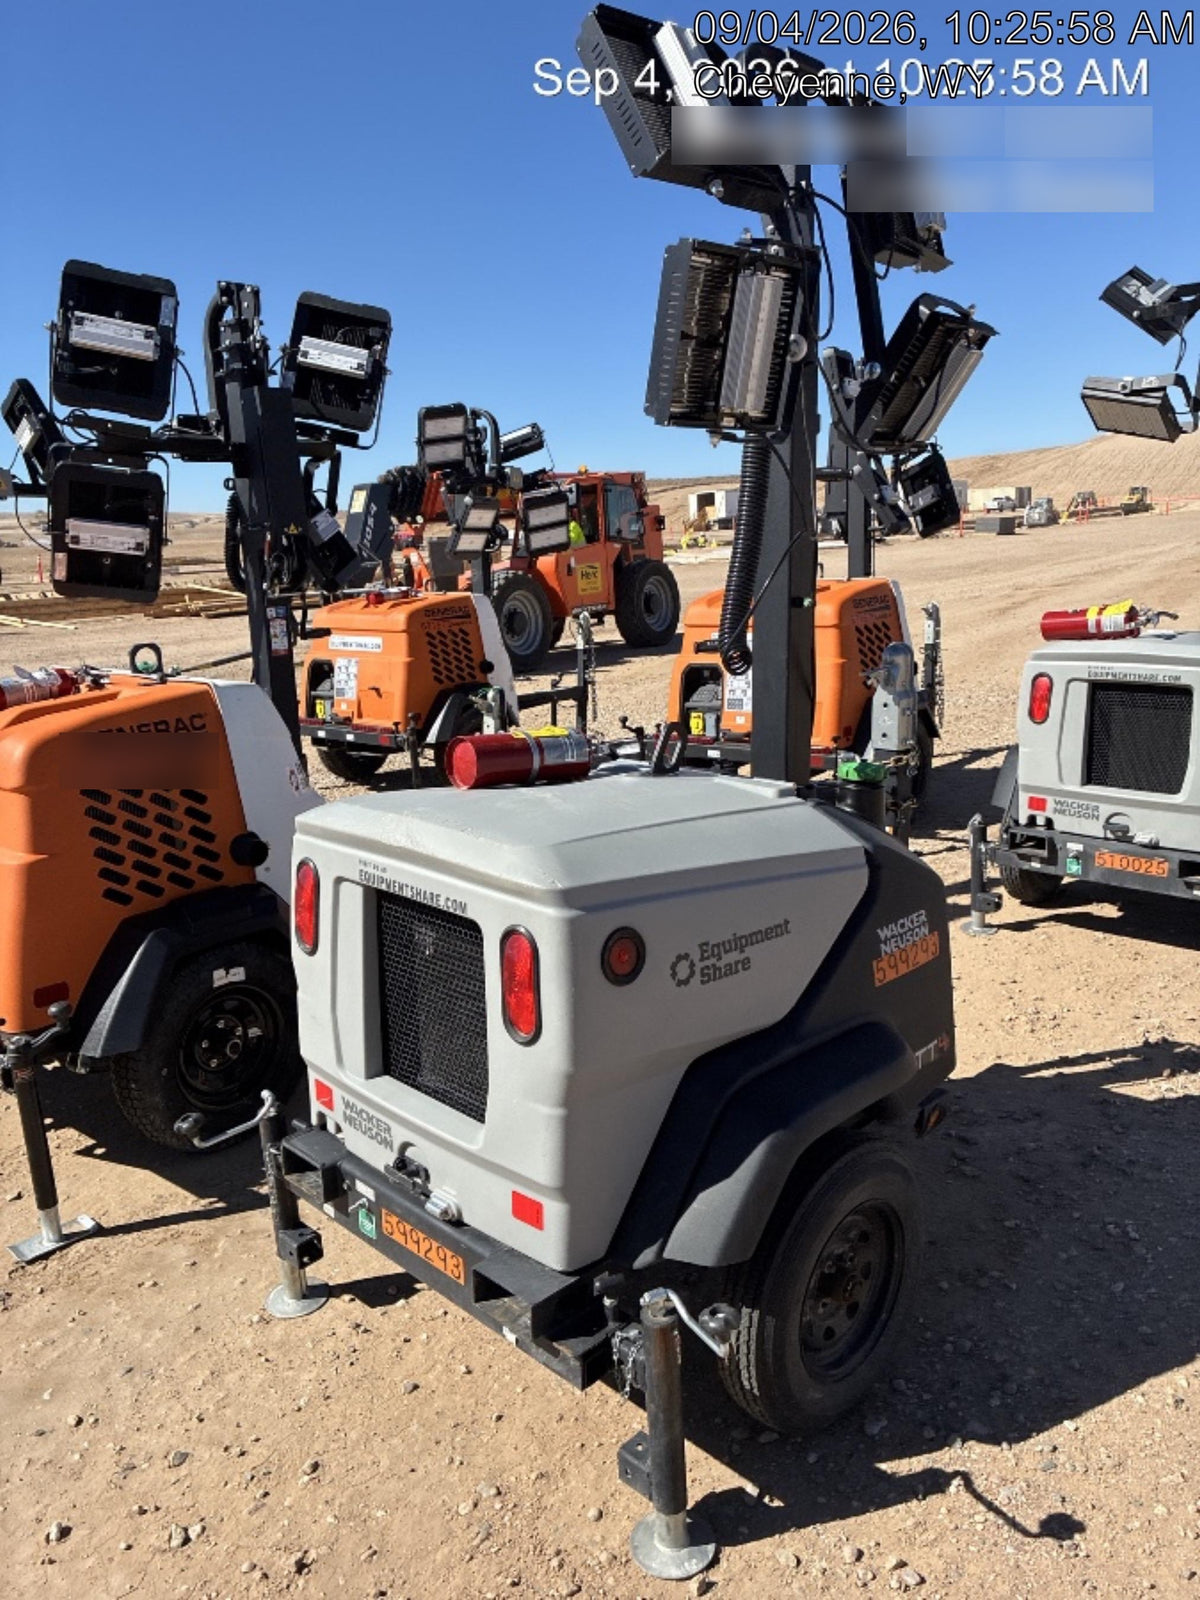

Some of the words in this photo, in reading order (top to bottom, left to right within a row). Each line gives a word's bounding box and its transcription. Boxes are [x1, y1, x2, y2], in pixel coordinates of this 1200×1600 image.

[1053, 807, 1100, 822] NEUSON
[1054, 798, 1100, 814] WACKER
[698, 918, 792, 962] Equipment
[876, 909, 928, 941] WACKER
[880, 923, 930, 957] NEUSON
[699, 956, 752, 985] Share
[874, 939, 939, 984] 599293
[341, 1095, 392, 1138] WACKER
[342, 1110, 395, 1153] NEUSON
[383, 1211, 463, 1281] 599293
